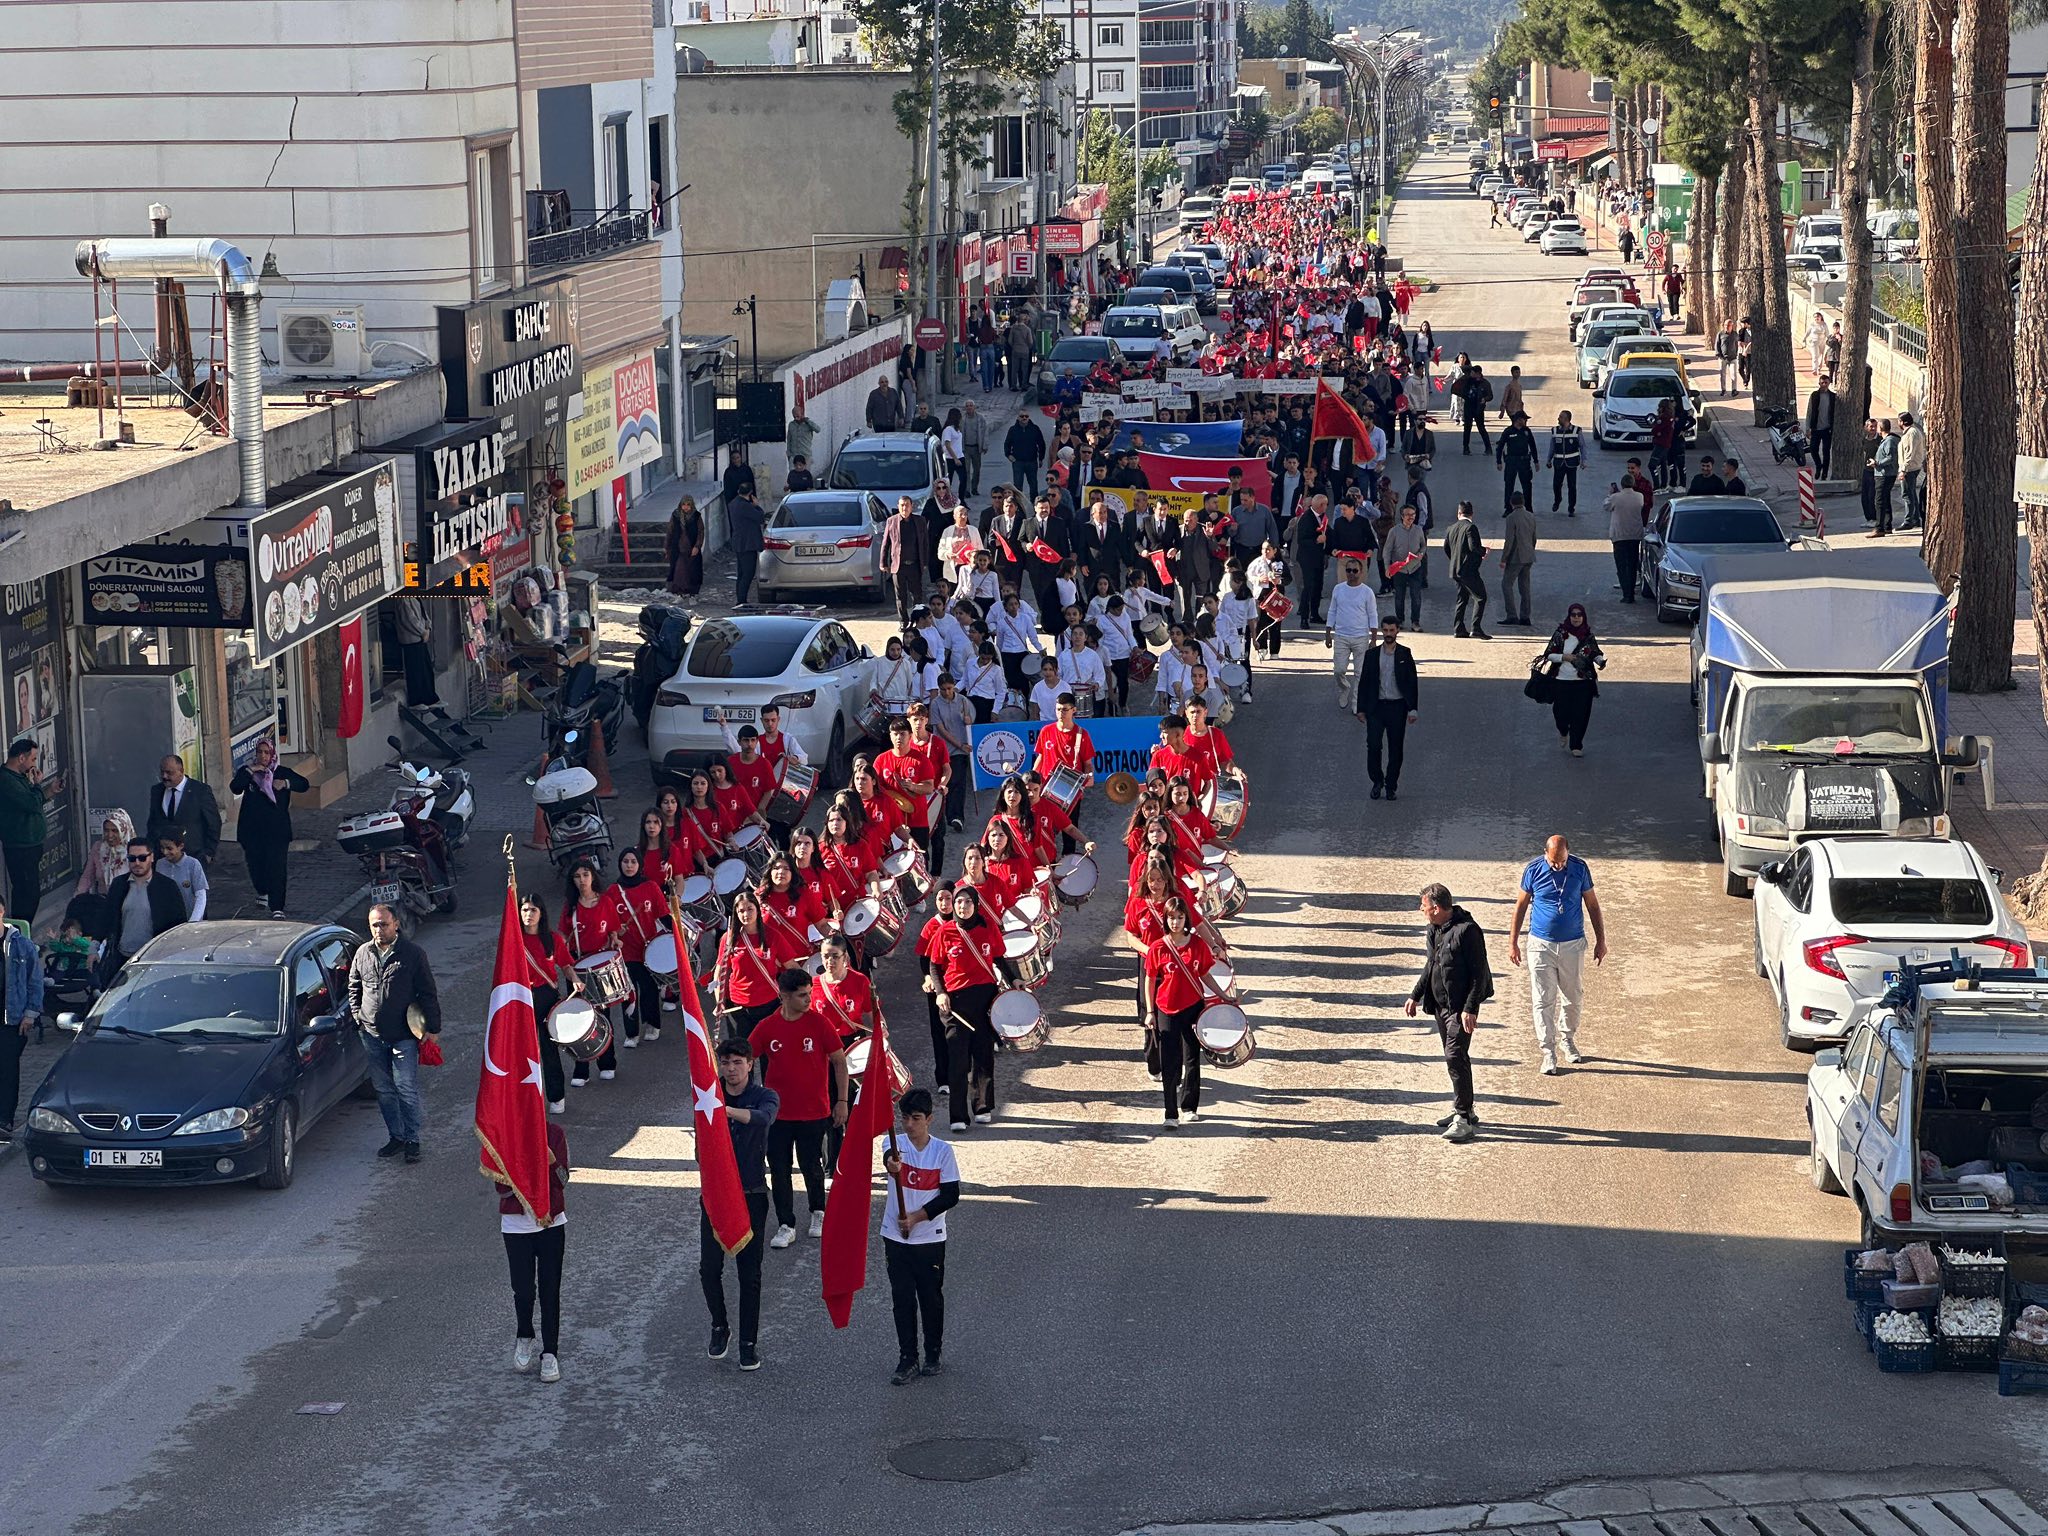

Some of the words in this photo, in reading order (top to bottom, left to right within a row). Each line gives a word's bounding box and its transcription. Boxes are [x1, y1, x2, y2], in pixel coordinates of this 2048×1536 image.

[1649, 236, 1660, 245] 30
[1015, 256, 1028, 271] E
[515, 301, 551, 341] BAHÇE
[493, 358, 532, 407] HUKUK
[534, 344, 575, 391] BÜROSU
[433, 432, 506, 500] YAKAR
[344, 486, 363, 507] DÖNER
[351, 508, 358, 522] &
[433, 486, 508, 565] İLETİŞİM
[333, 524, 358, 550] TANTUNİ
[357, 517, 378, 538] SALONU
[93, 557, 198, 580] VİTAMİN
[89, 581, 165, 592] DÖNER&TANTUNİ
[167, 584, 205, 593] SALONU
[1810, 785, 1873, 799] YATMAZLAR
[91, 1151, 103, 1164] 01
[112, 1151, 127, 1164] EN
[140, 1151, 160, 1165] 254
